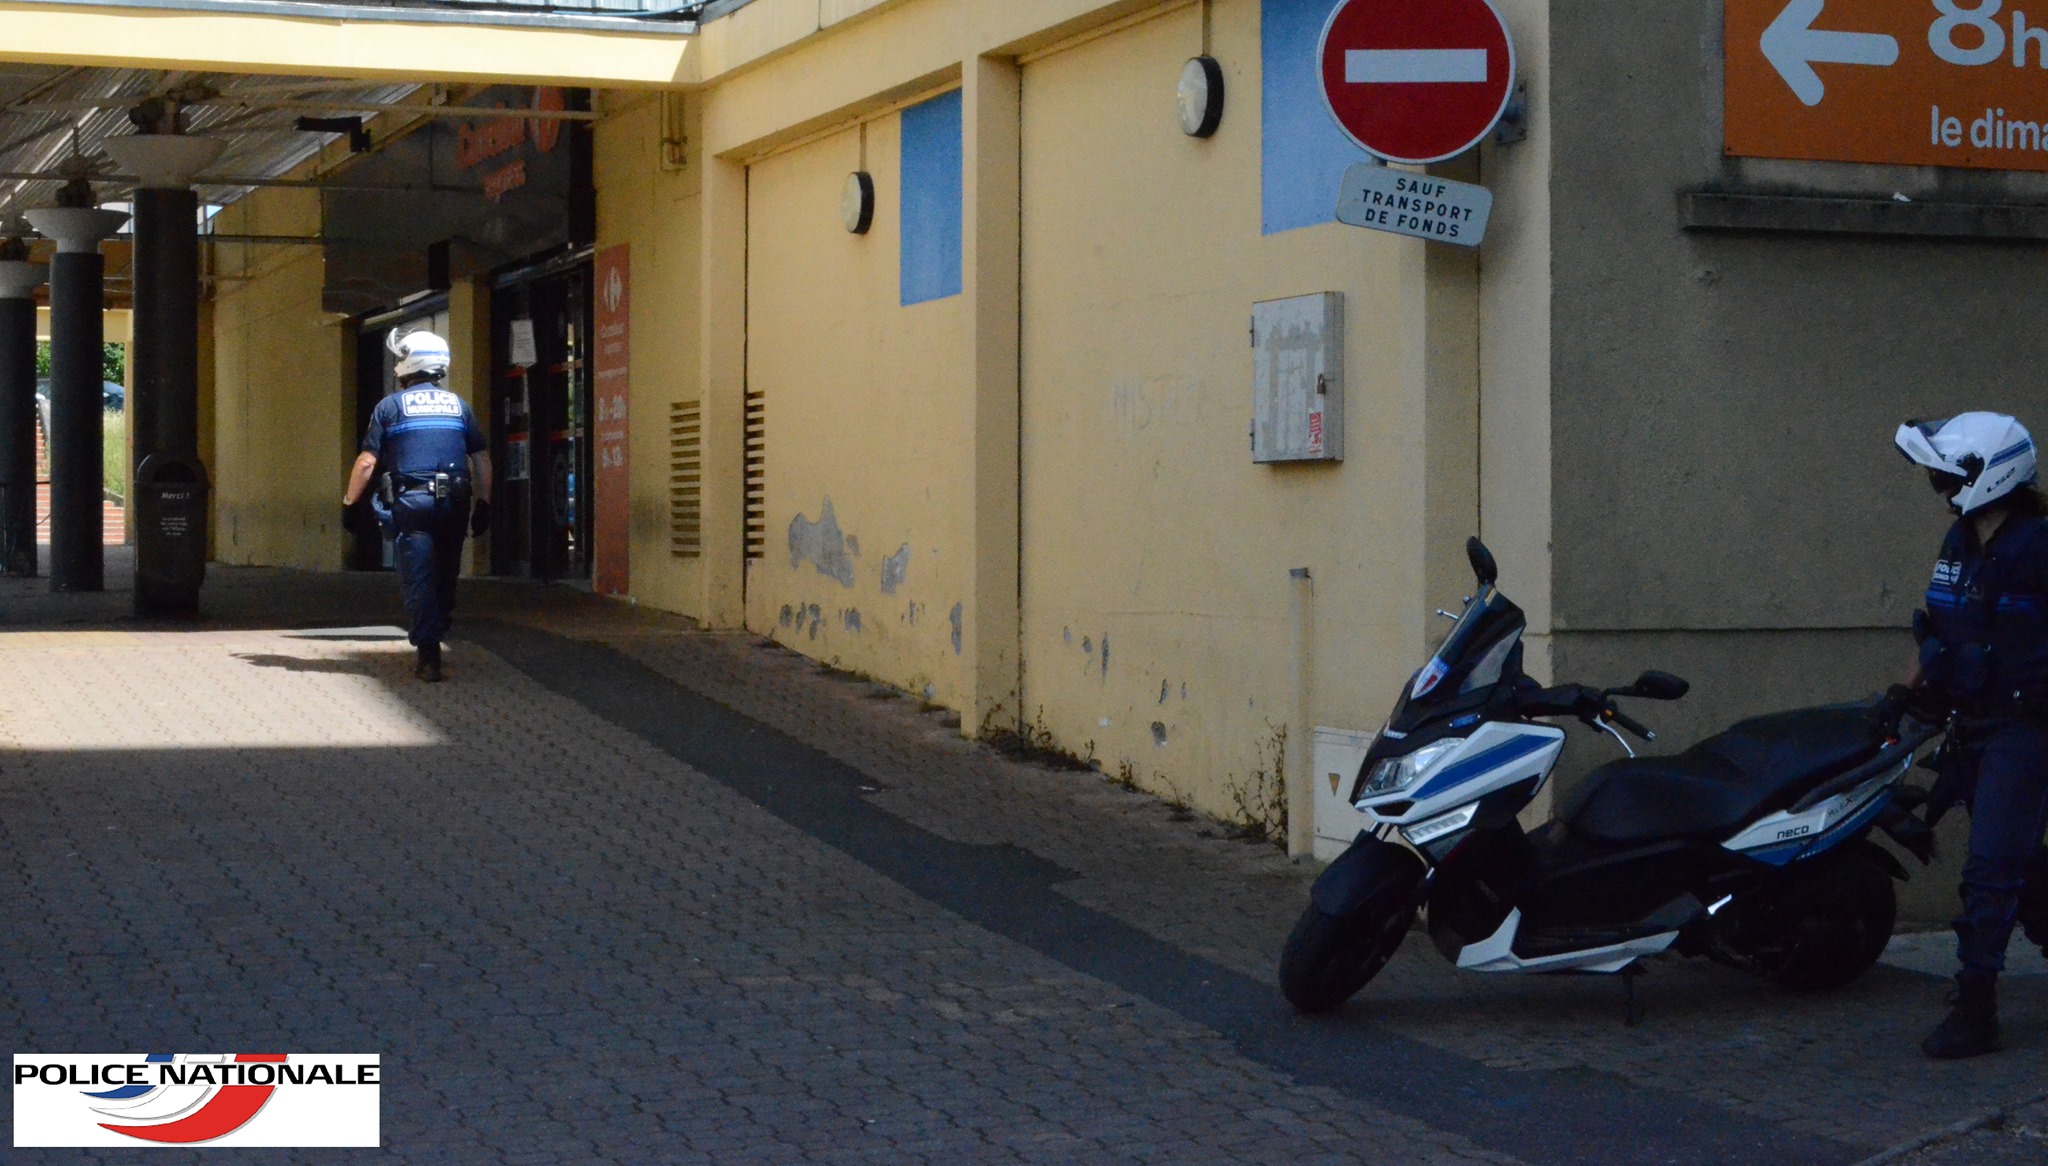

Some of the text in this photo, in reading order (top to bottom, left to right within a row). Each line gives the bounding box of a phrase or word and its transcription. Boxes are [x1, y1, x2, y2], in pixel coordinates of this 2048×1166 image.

[1931, 104, 1962, 147] le
[1396, 178, 1446, 198] SAUF
[1362, 189, 1473, 222] TRANSPORT
[1365, 208, 1460, 237] DE FONDS
[405, 391, 458, 405] POLICE
[1776, 825, 1809, 840] neco
